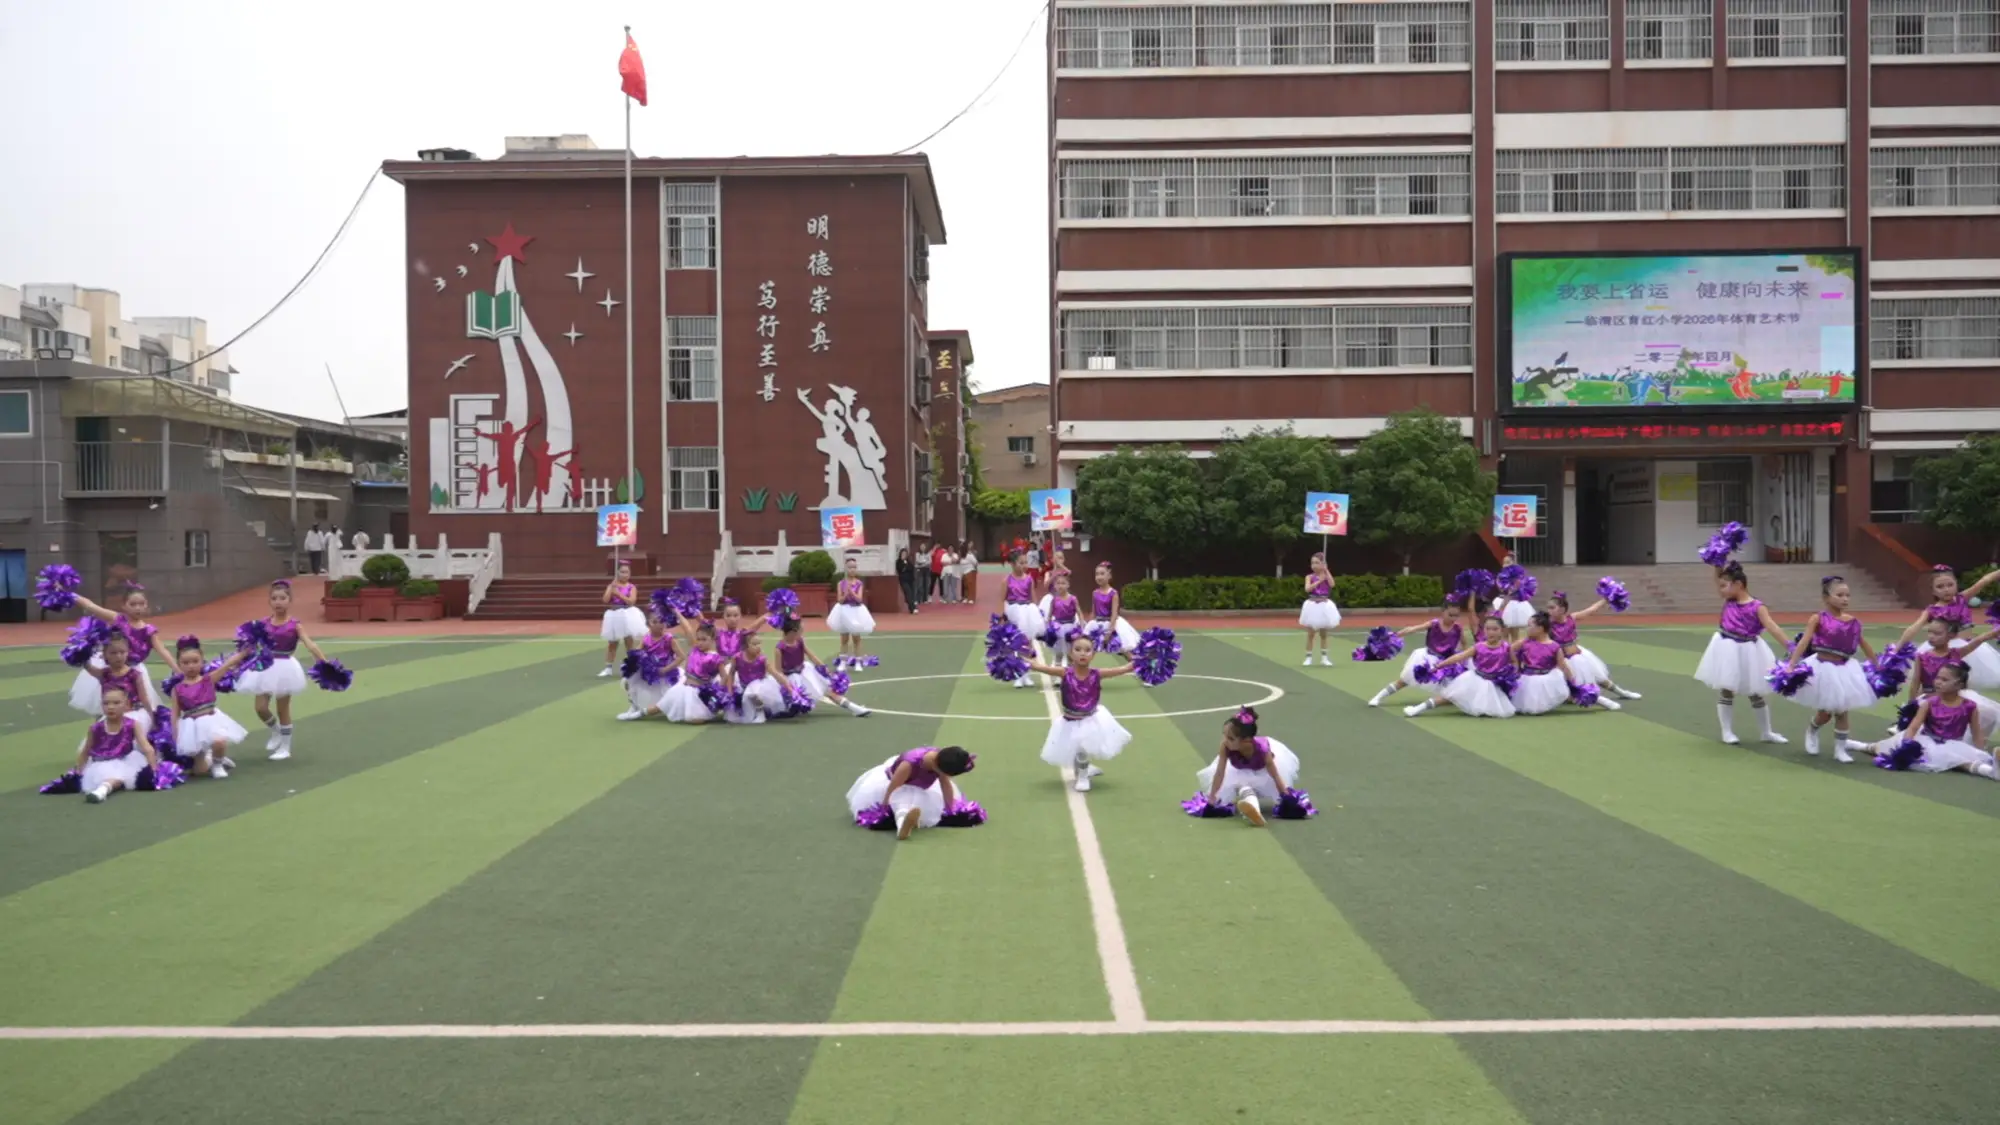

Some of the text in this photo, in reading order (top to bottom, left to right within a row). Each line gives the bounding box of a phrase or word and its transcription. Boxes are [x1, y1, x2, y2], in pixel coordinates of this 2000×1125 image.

[807, 214, 834, 353] 明德崇真
[1556, 280, 1810, 300] 我要上省运 健康向未来
[756, 280, 781, 402] 笃行至善
[1042, 497, 1064, 522] 上
[1315, 501, 1340, 527] 省
[1503, 503, 1528, 528] 运
[606, 512, 629, 537] 我
[831, 515, 855, 539] 要
